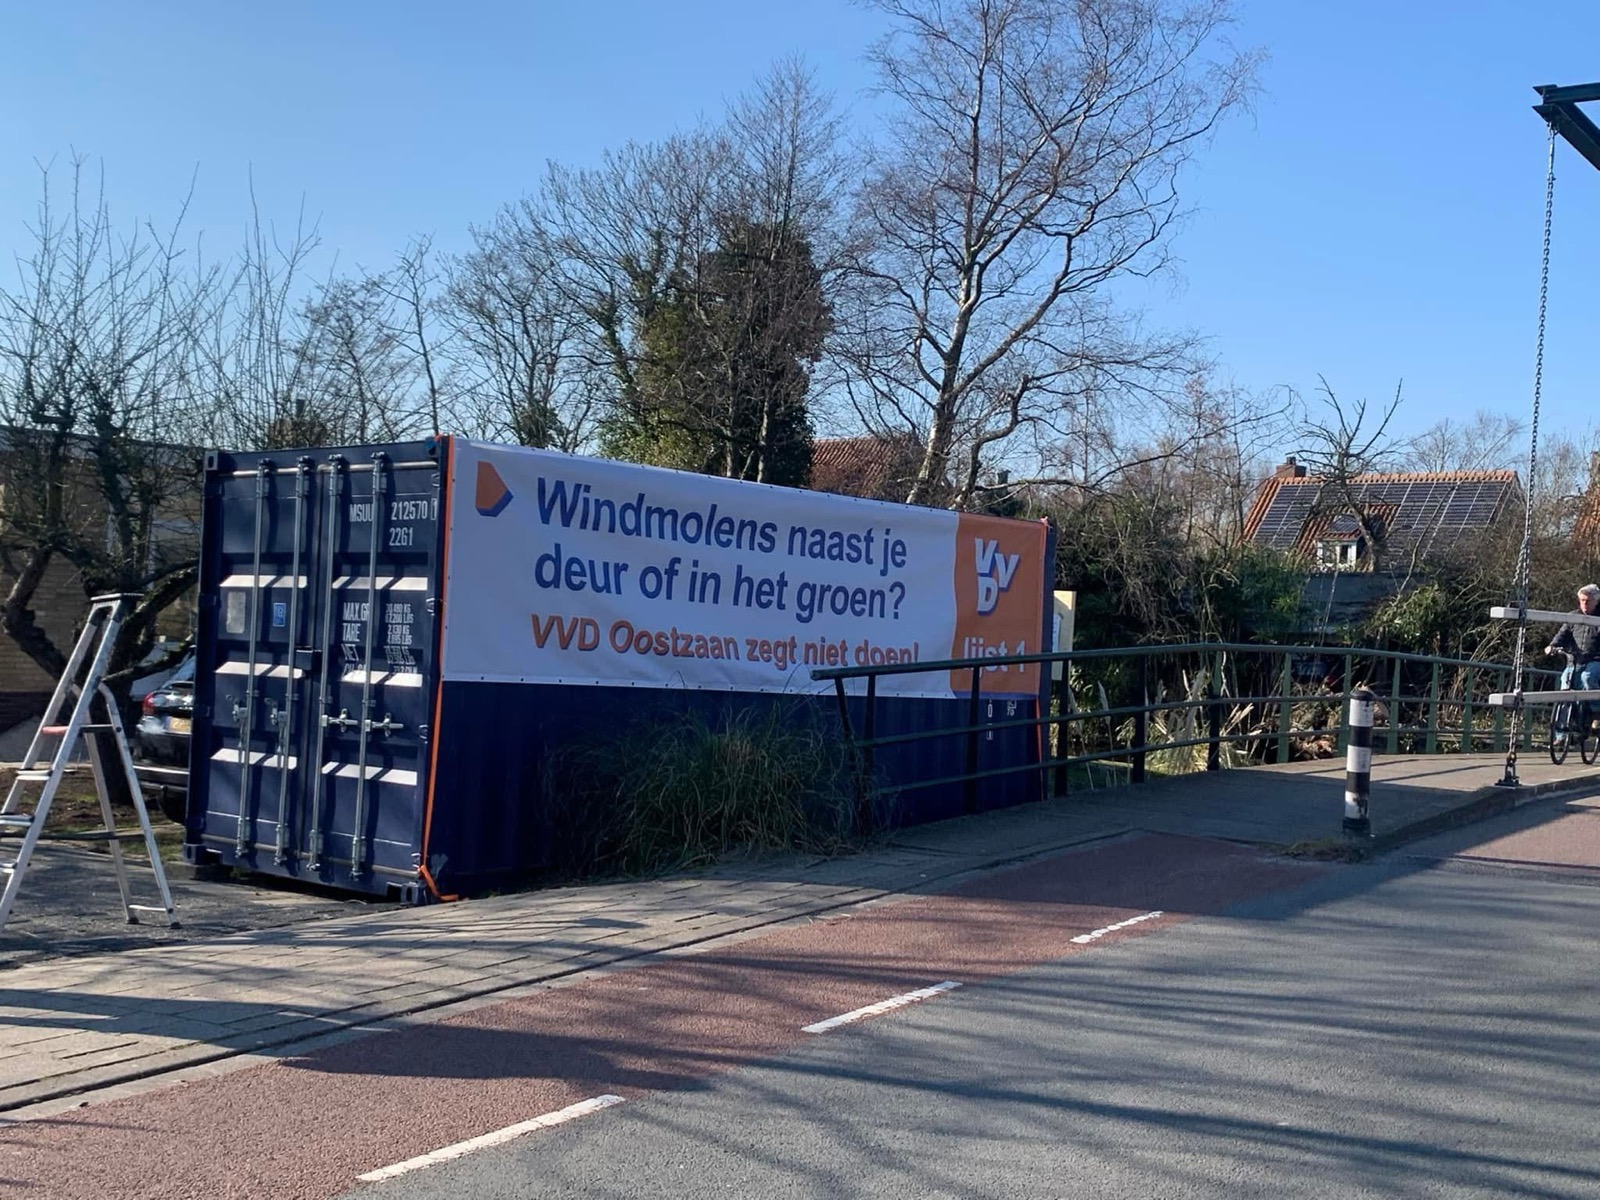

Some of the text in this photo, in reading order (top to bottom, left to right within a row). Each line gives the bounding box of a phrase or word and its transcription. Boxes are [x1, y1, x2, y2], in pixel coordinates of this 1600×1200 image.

[391, 500, 428, 521] 212570
[537, 477, 907, 577] Windmolens naast je
[535, 543, 906, 624] deur of in het groen?
[974, 537, 1020, 616] VVD
[341, 643, 359, 661] NET
[342, 623, 361, 642] TARE
[531, 613, 919, 671] VVD Oostzaan zegt niet doen!
[962, 636, 1026, 678] lijst 1
